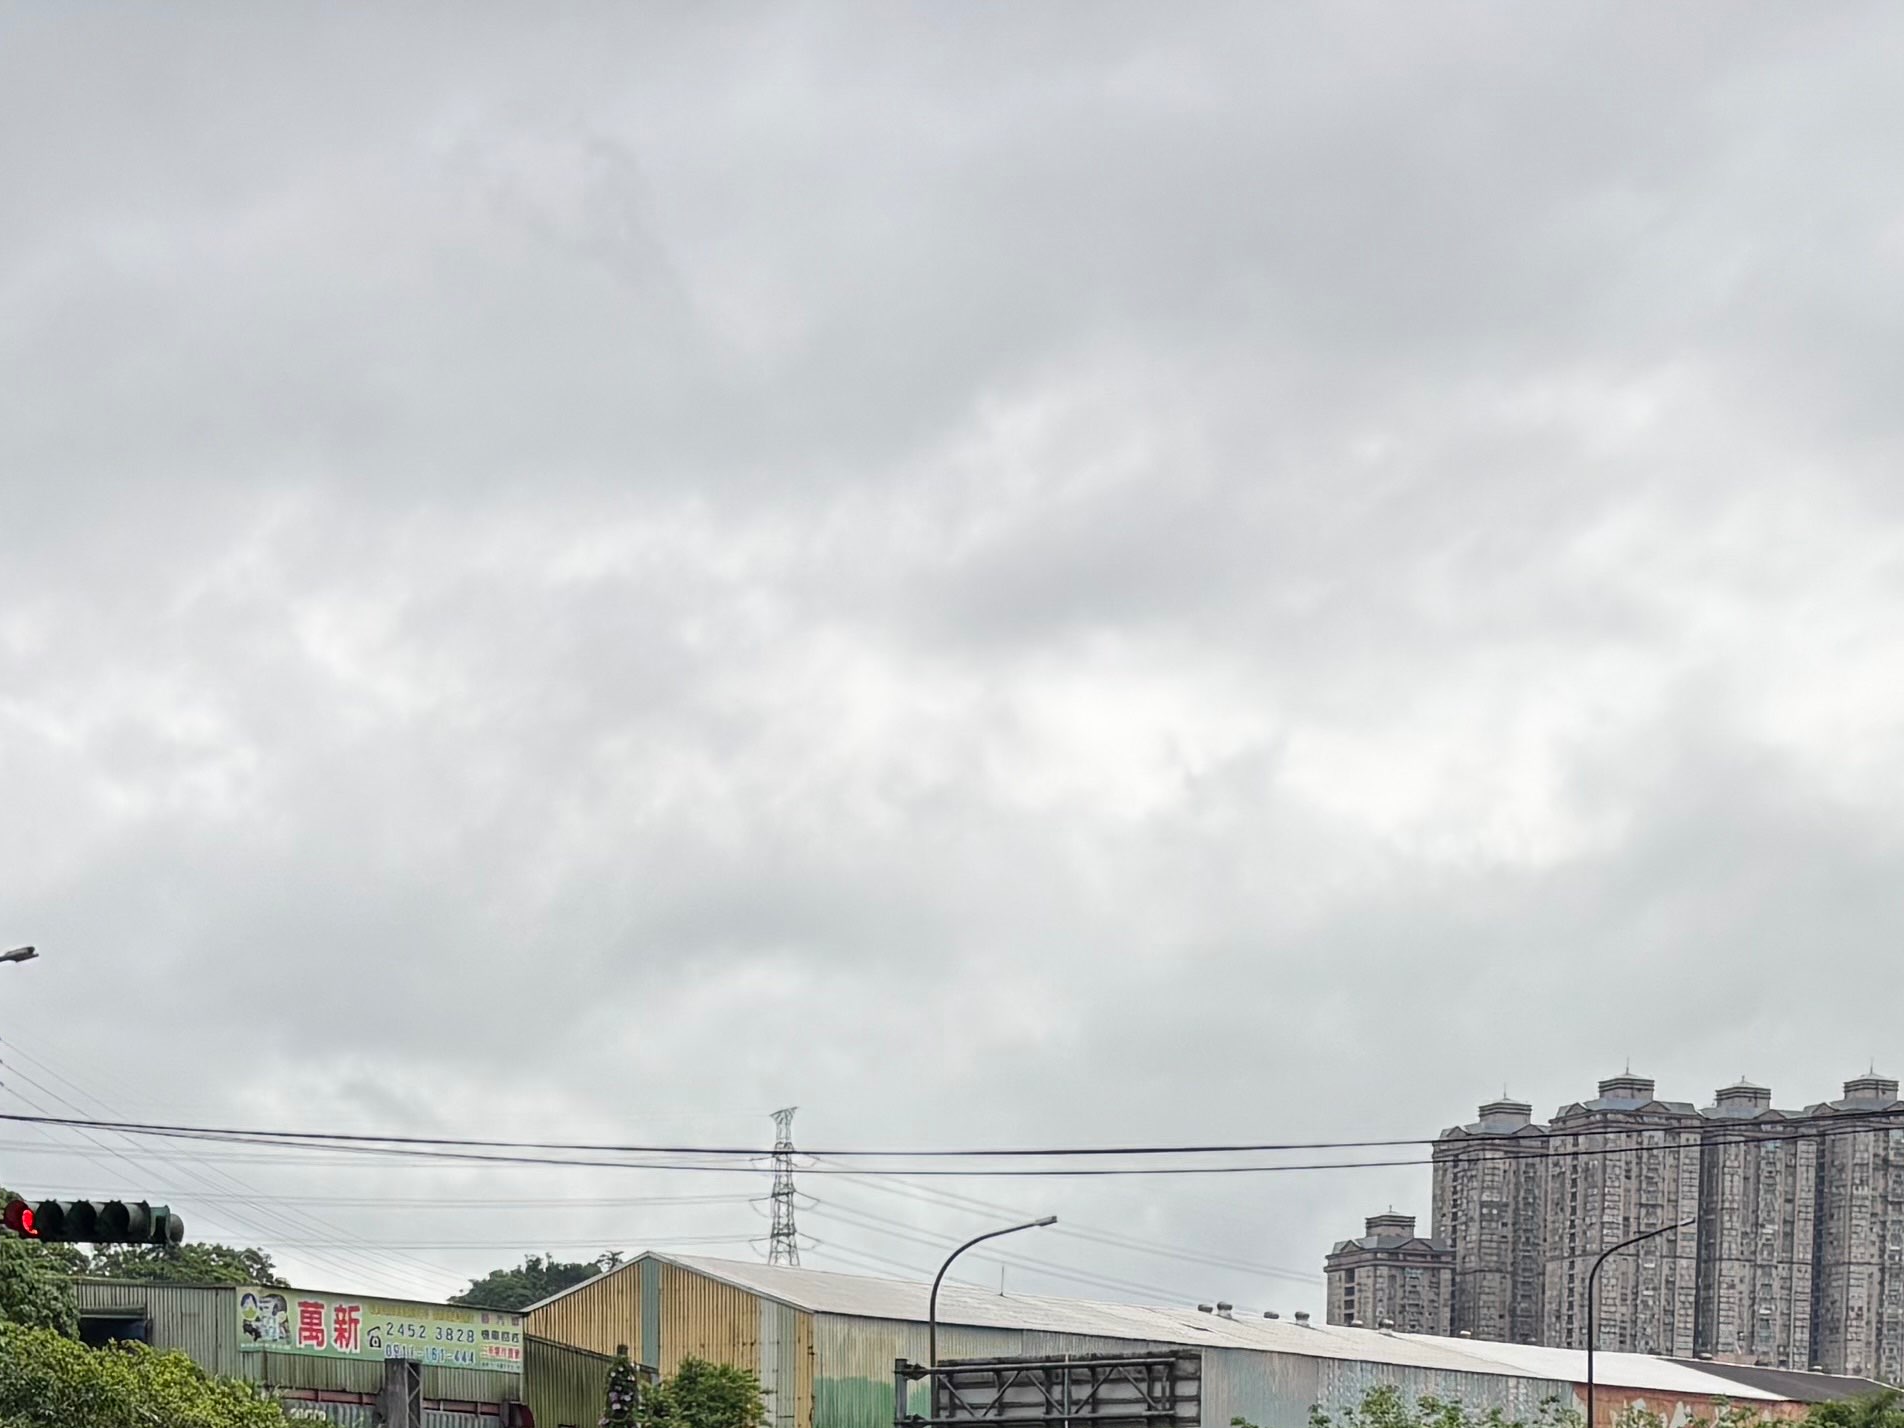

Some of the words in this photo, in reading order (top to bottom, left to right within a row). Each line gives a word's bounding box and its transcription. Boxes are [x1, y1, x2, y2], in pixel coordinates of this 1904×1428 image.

[297, 1301, 361, 1351] 萬新
[386, 1322, 427, 1339] 2452
[435, 1326, 475, 1344] 3828
